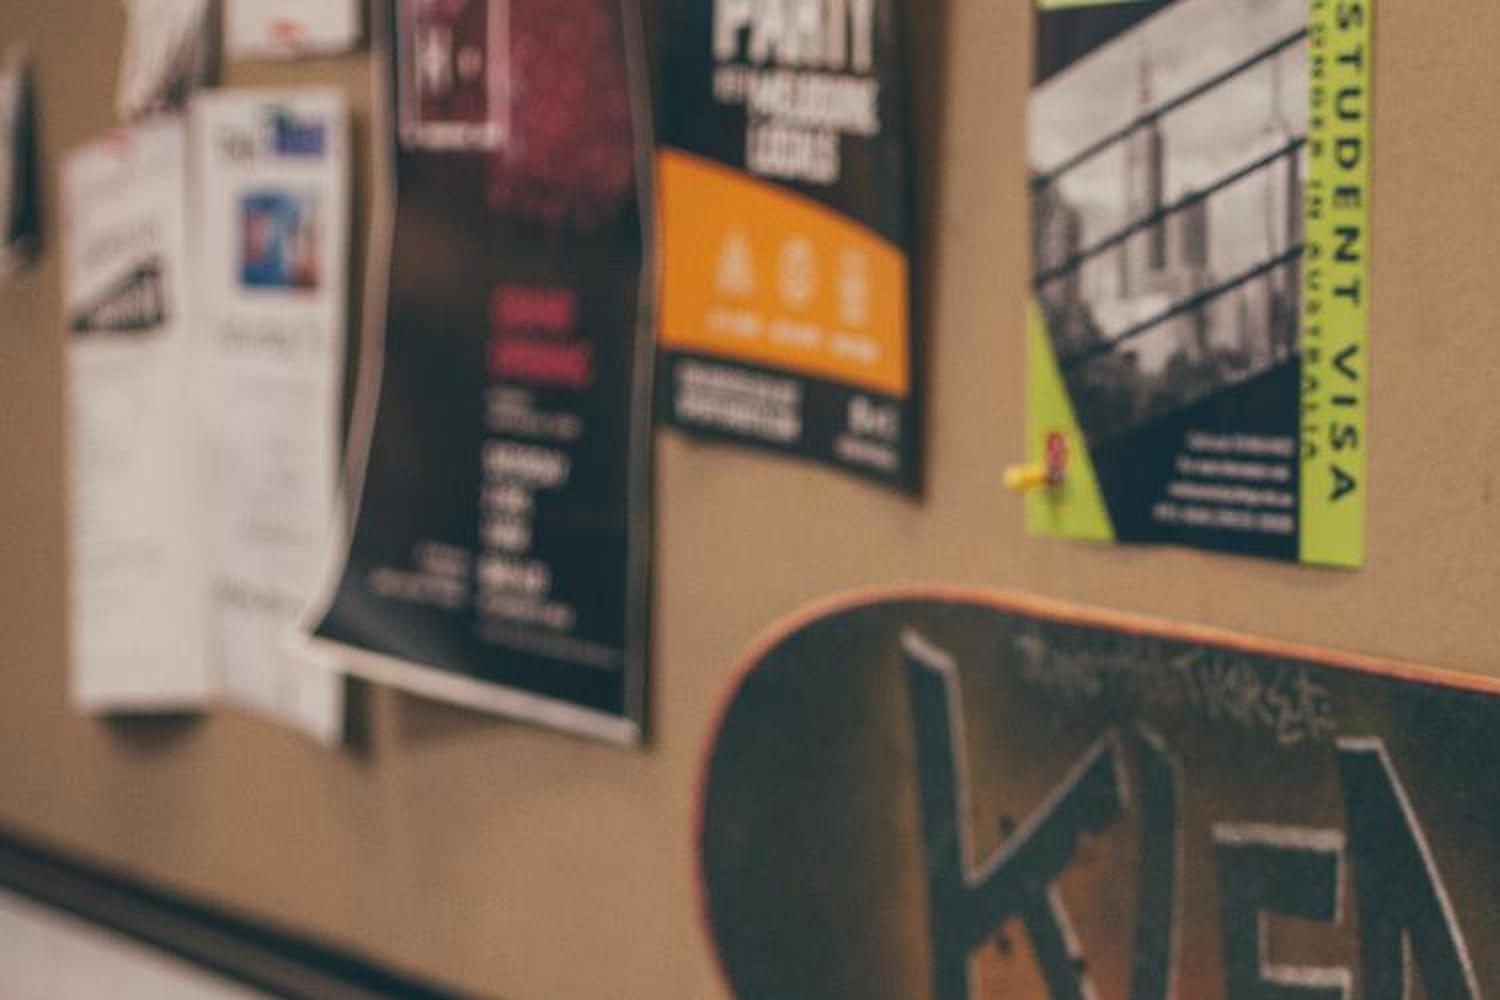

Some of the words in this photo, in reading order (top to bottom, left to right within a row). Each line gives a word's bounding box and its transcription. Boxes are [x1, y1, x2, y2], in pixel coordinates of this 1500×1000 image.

[1333, 0, 1366, 307] STUDENT
[1301, 240, 1321, 461] AUSTRALIA
[1329, 344, 1360, 502] VISA
